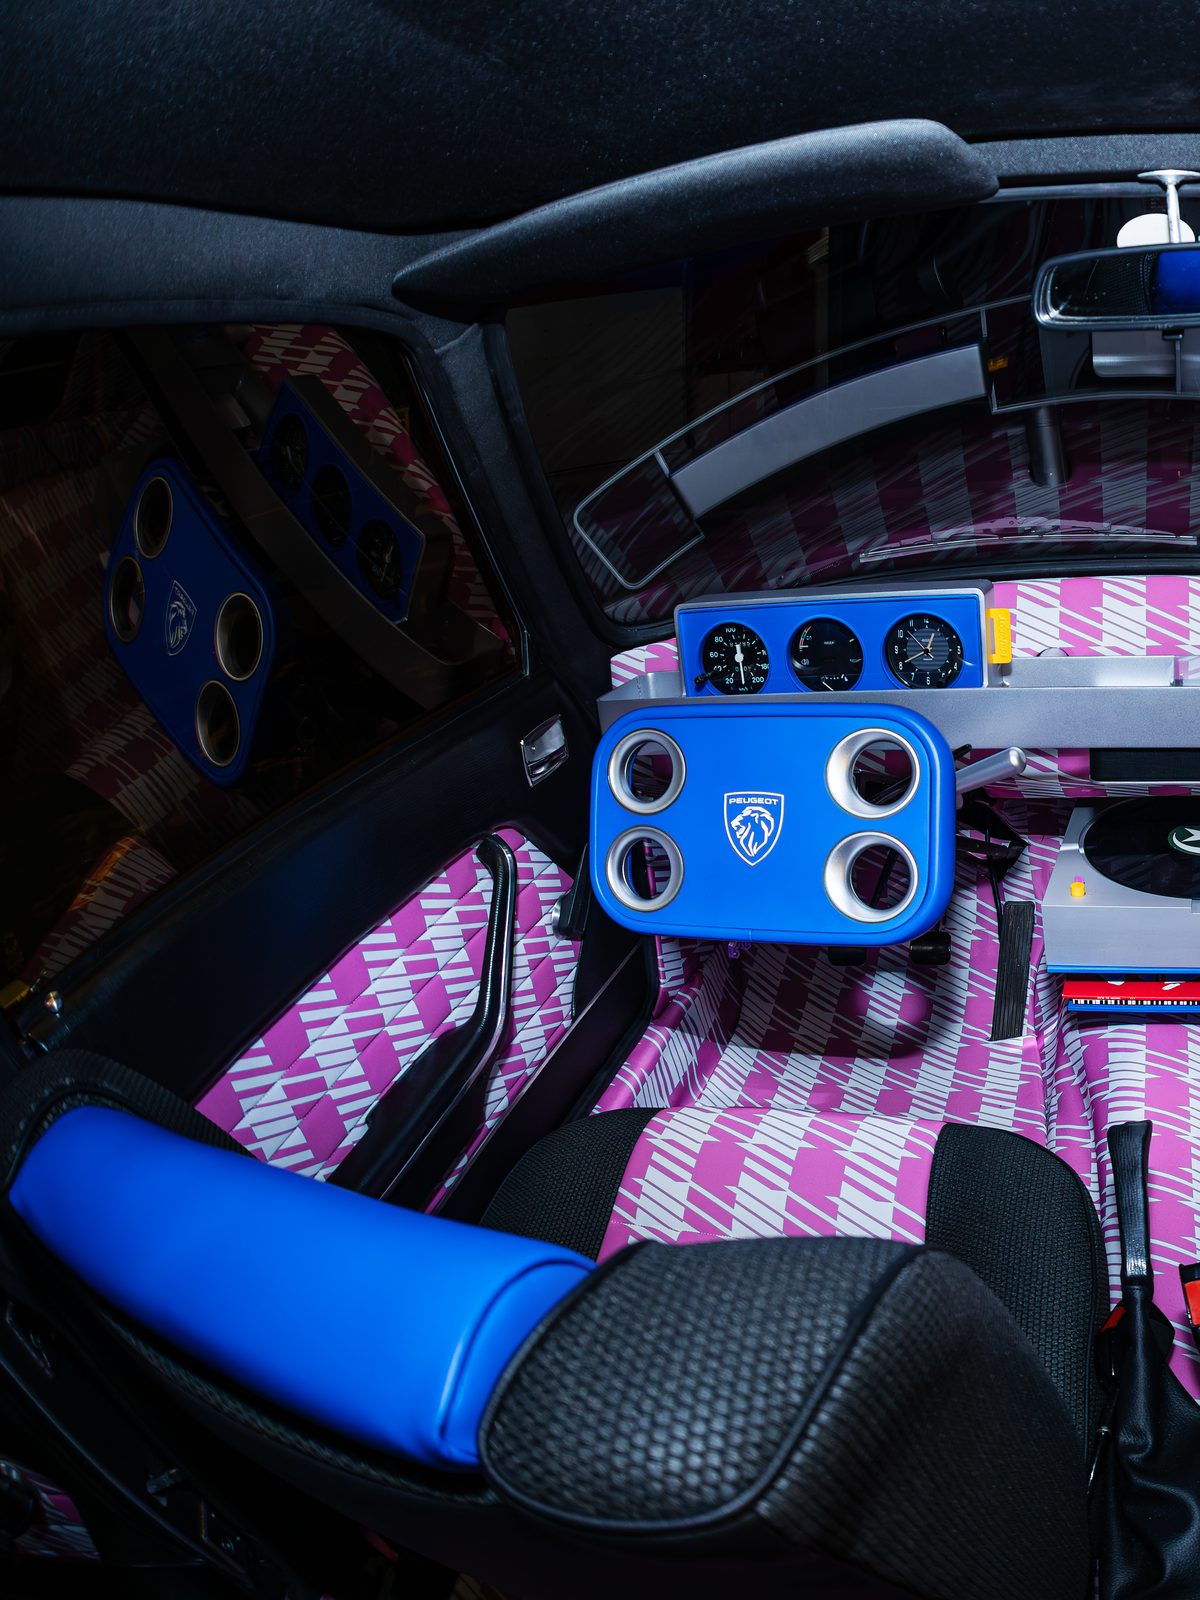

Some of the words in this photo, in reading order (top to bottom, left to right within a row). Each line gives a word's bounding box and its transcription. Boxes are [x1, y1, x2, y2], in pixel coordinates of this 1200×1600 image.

[909, 619, 914, 627] 11
[897, 629, 904, 639] 10
[894, 645, 899, 655] 9
[898, 661, 904, 671] 8
[953, 661, 958, 671] 4
[751, 676, 765, 684] 200
[910, 672, 915, 681] 7
[926, 676, 931, 686] 6
[728, 797, 779, 805] PEUGEOT
